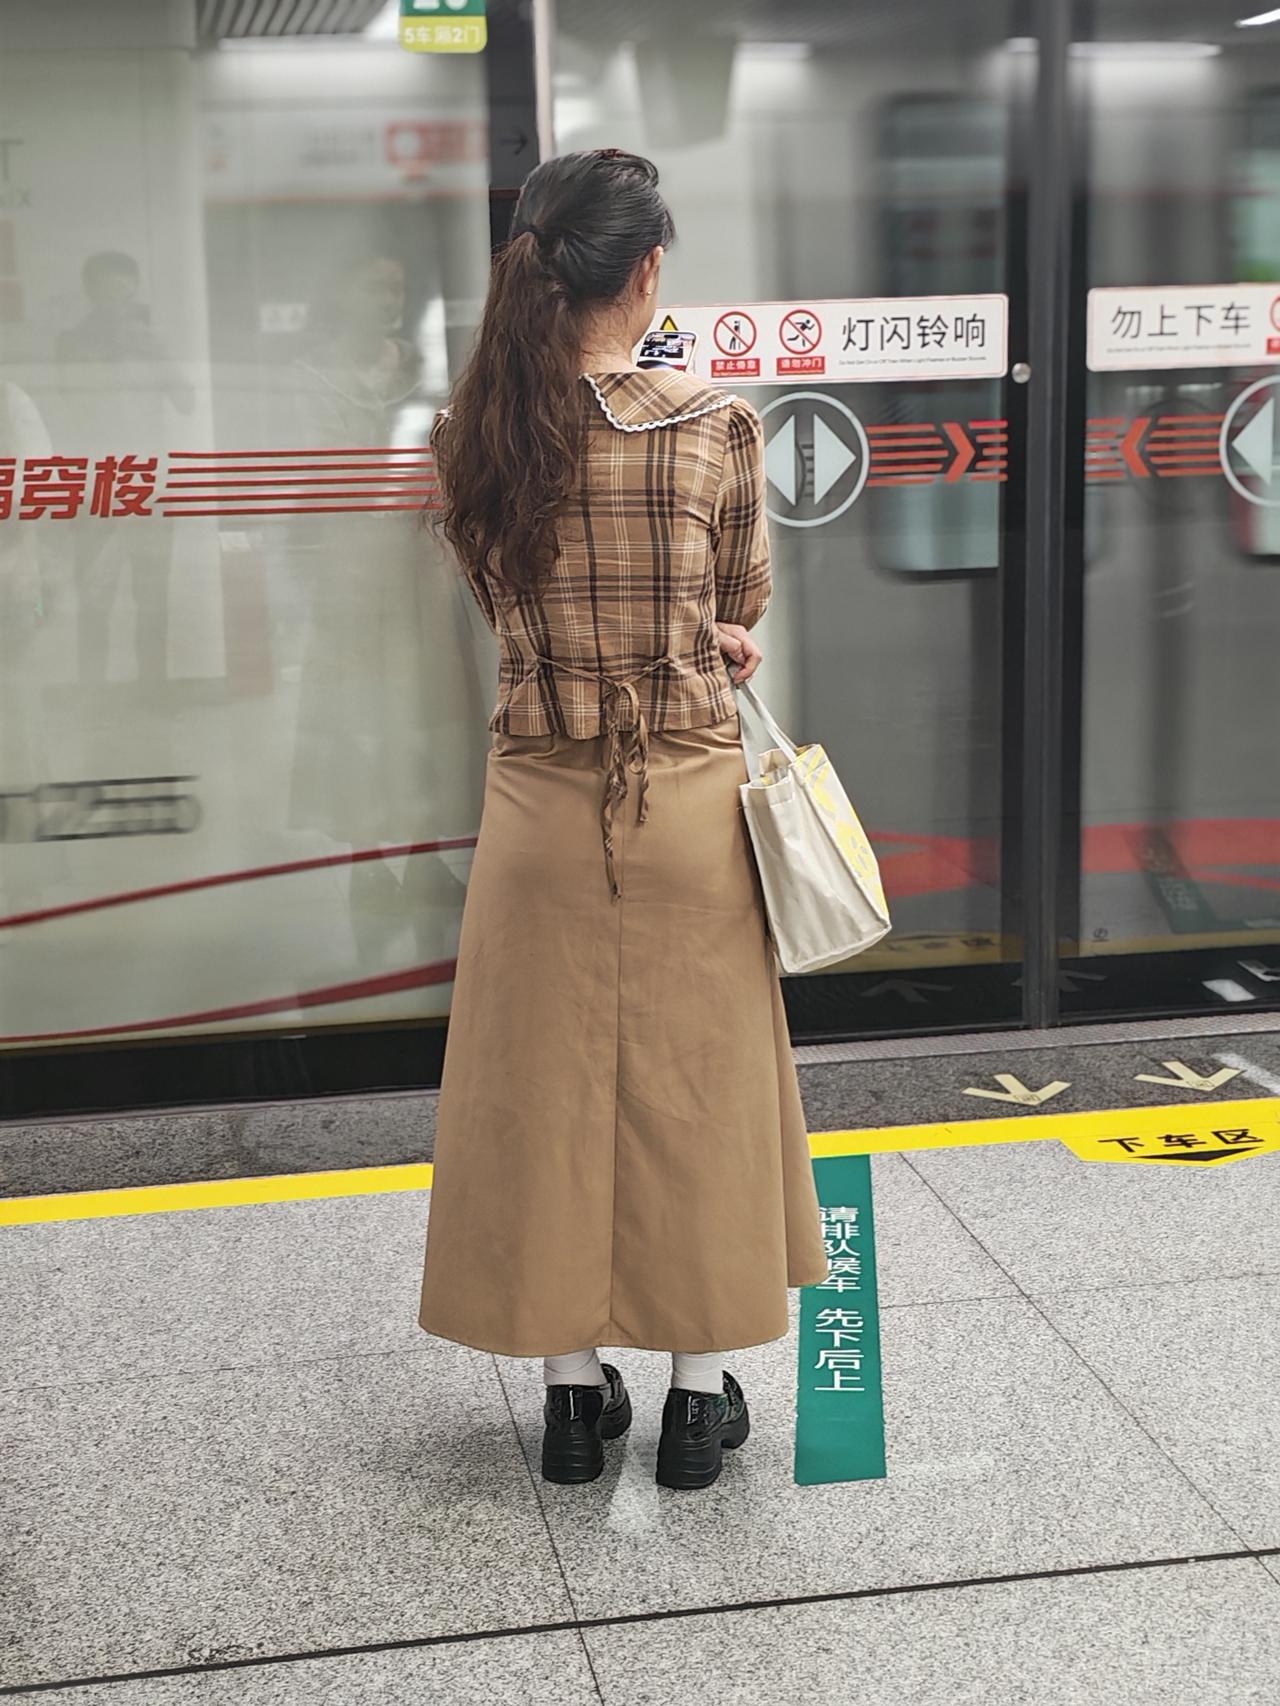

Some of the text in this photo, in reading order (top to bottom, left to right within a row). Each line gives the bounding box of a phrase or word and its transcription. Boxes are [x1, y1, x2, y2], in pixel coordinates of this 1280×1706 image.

[842, 313, 985, 351] 灯闪铃响
[1112, 302, 1250, 338] 勿上下车
[1097, 1128, 1265, 1153] 下车区
[814, 1308, 865, 1391] 先下后上
